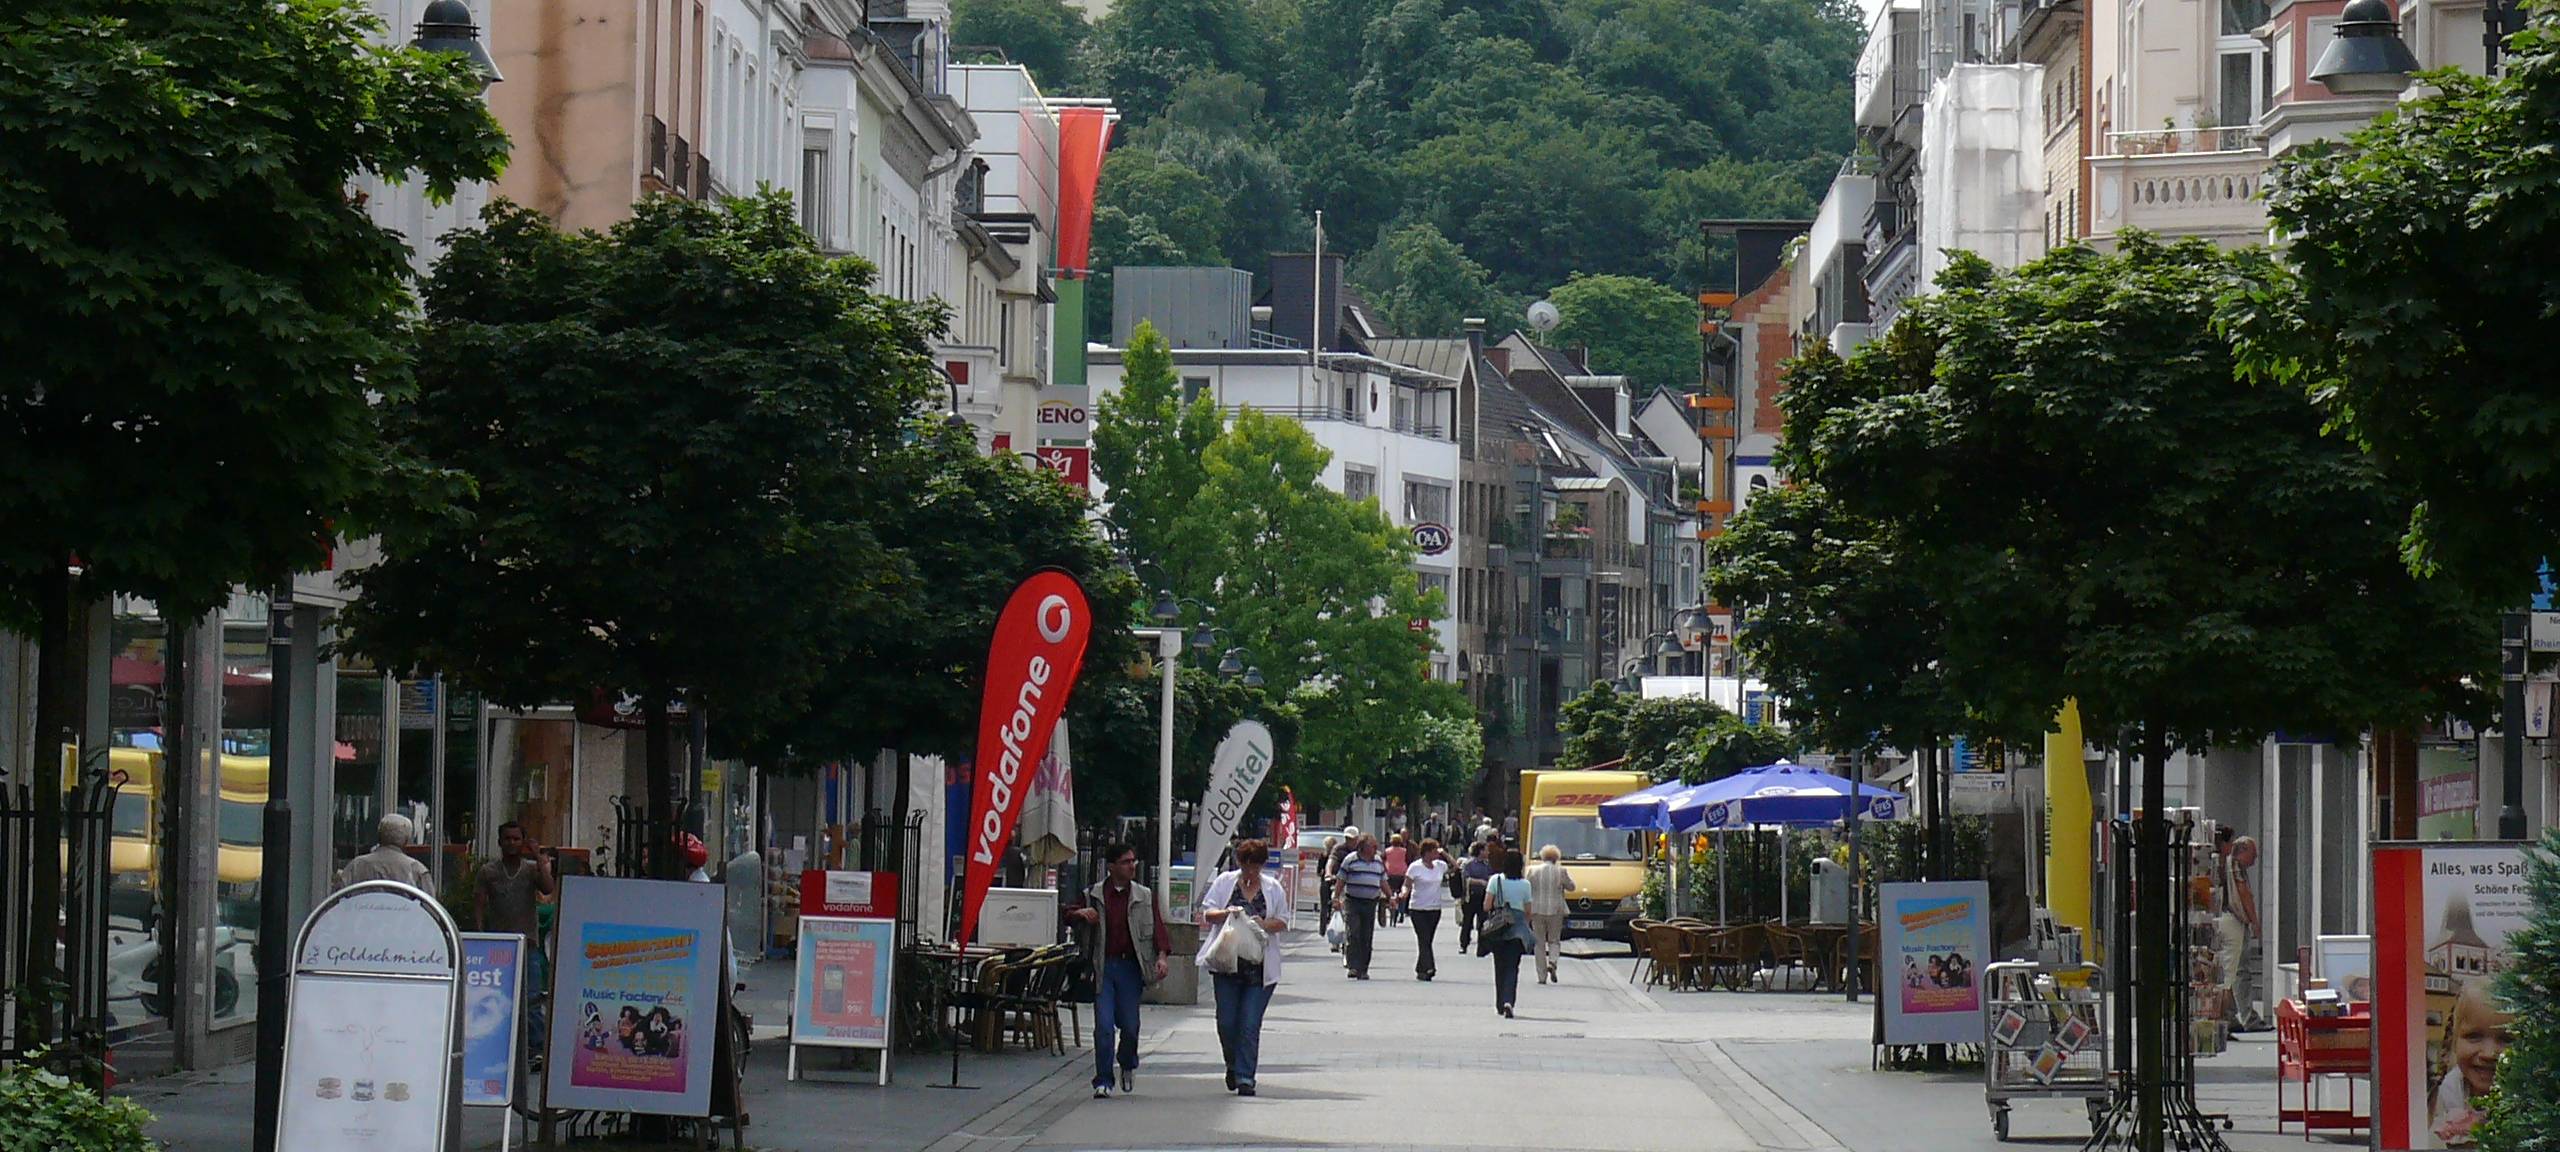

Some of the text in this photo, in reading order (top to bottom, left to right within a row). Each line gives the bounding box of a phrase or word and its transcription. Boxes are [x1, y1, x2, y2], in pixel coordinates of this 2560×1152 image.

[1415, 530, 1443, 547] C&A
[1601, 594, 1616, 671] MANI
[973, 654, 1051, 867] vodafone
[1208, 739, 1269, 836] debitel
[2430, 861, 2465, 877] Alles,
[2470, 863, 2494, 876] was
[2474, 883, 2509, 895] Schöne
[823, 903, 874, 913] vodafone
[327, 945, 444, 966] Goldschmiede
[465, 955, 484, 966] ser
[467, 968, 503, 986] est
[582, 988, 615, 1001] Music
[619, 990, 664, 1005] Factory
